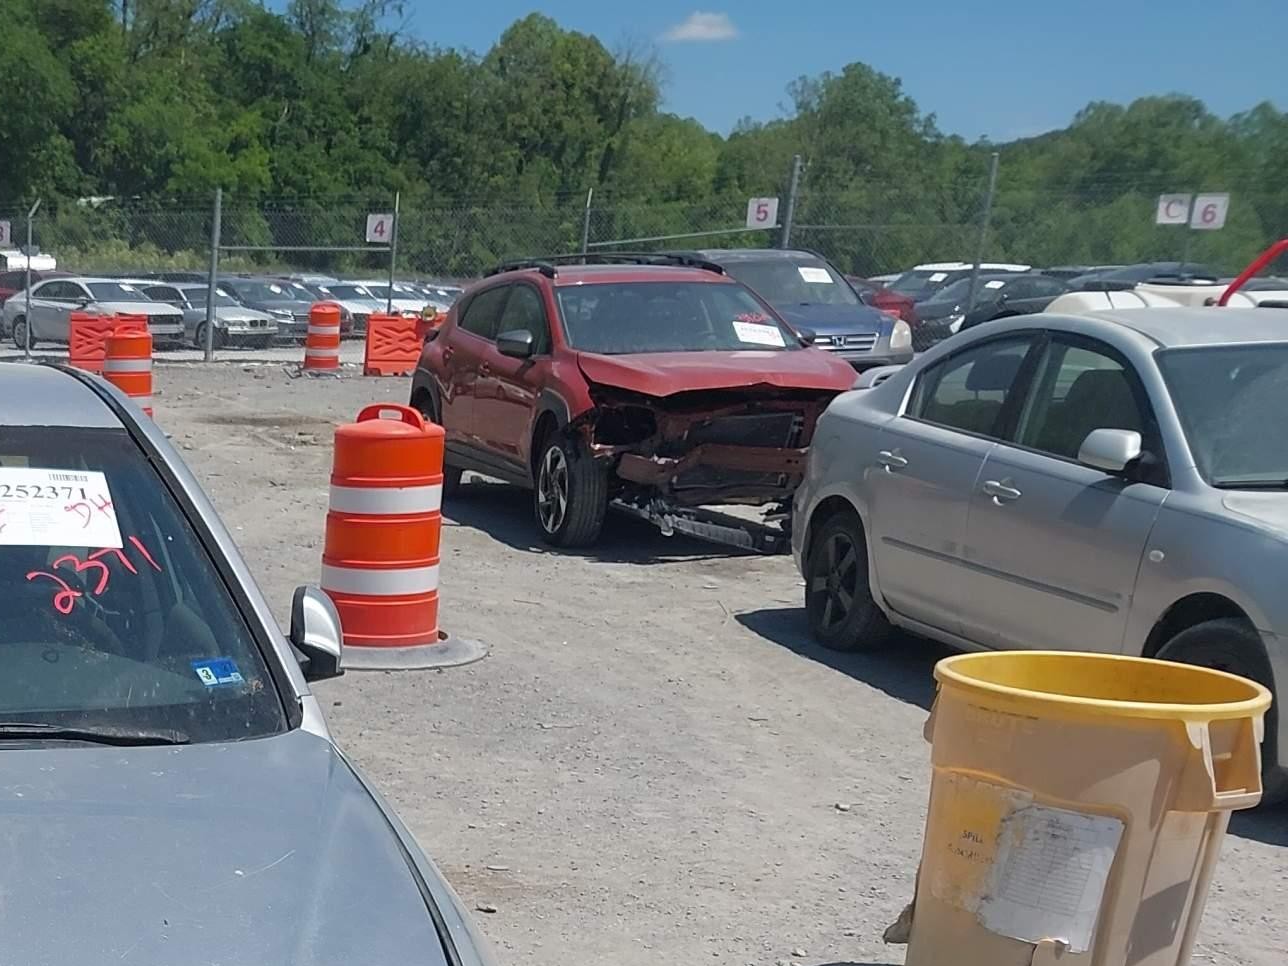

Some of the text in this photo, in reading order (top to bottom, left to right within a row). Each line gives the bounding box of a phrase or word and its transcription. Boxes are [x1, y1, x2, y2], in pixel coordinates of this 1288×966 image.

[756, 203, 769, 222] 5
[1164, 199, 1185, 219] C
[1202, 203, 1218, 224] 6
[373, 220, 386, 238] 4
[25, 535, 163, 614] 2371
[201, 669, 212, 680] 3
